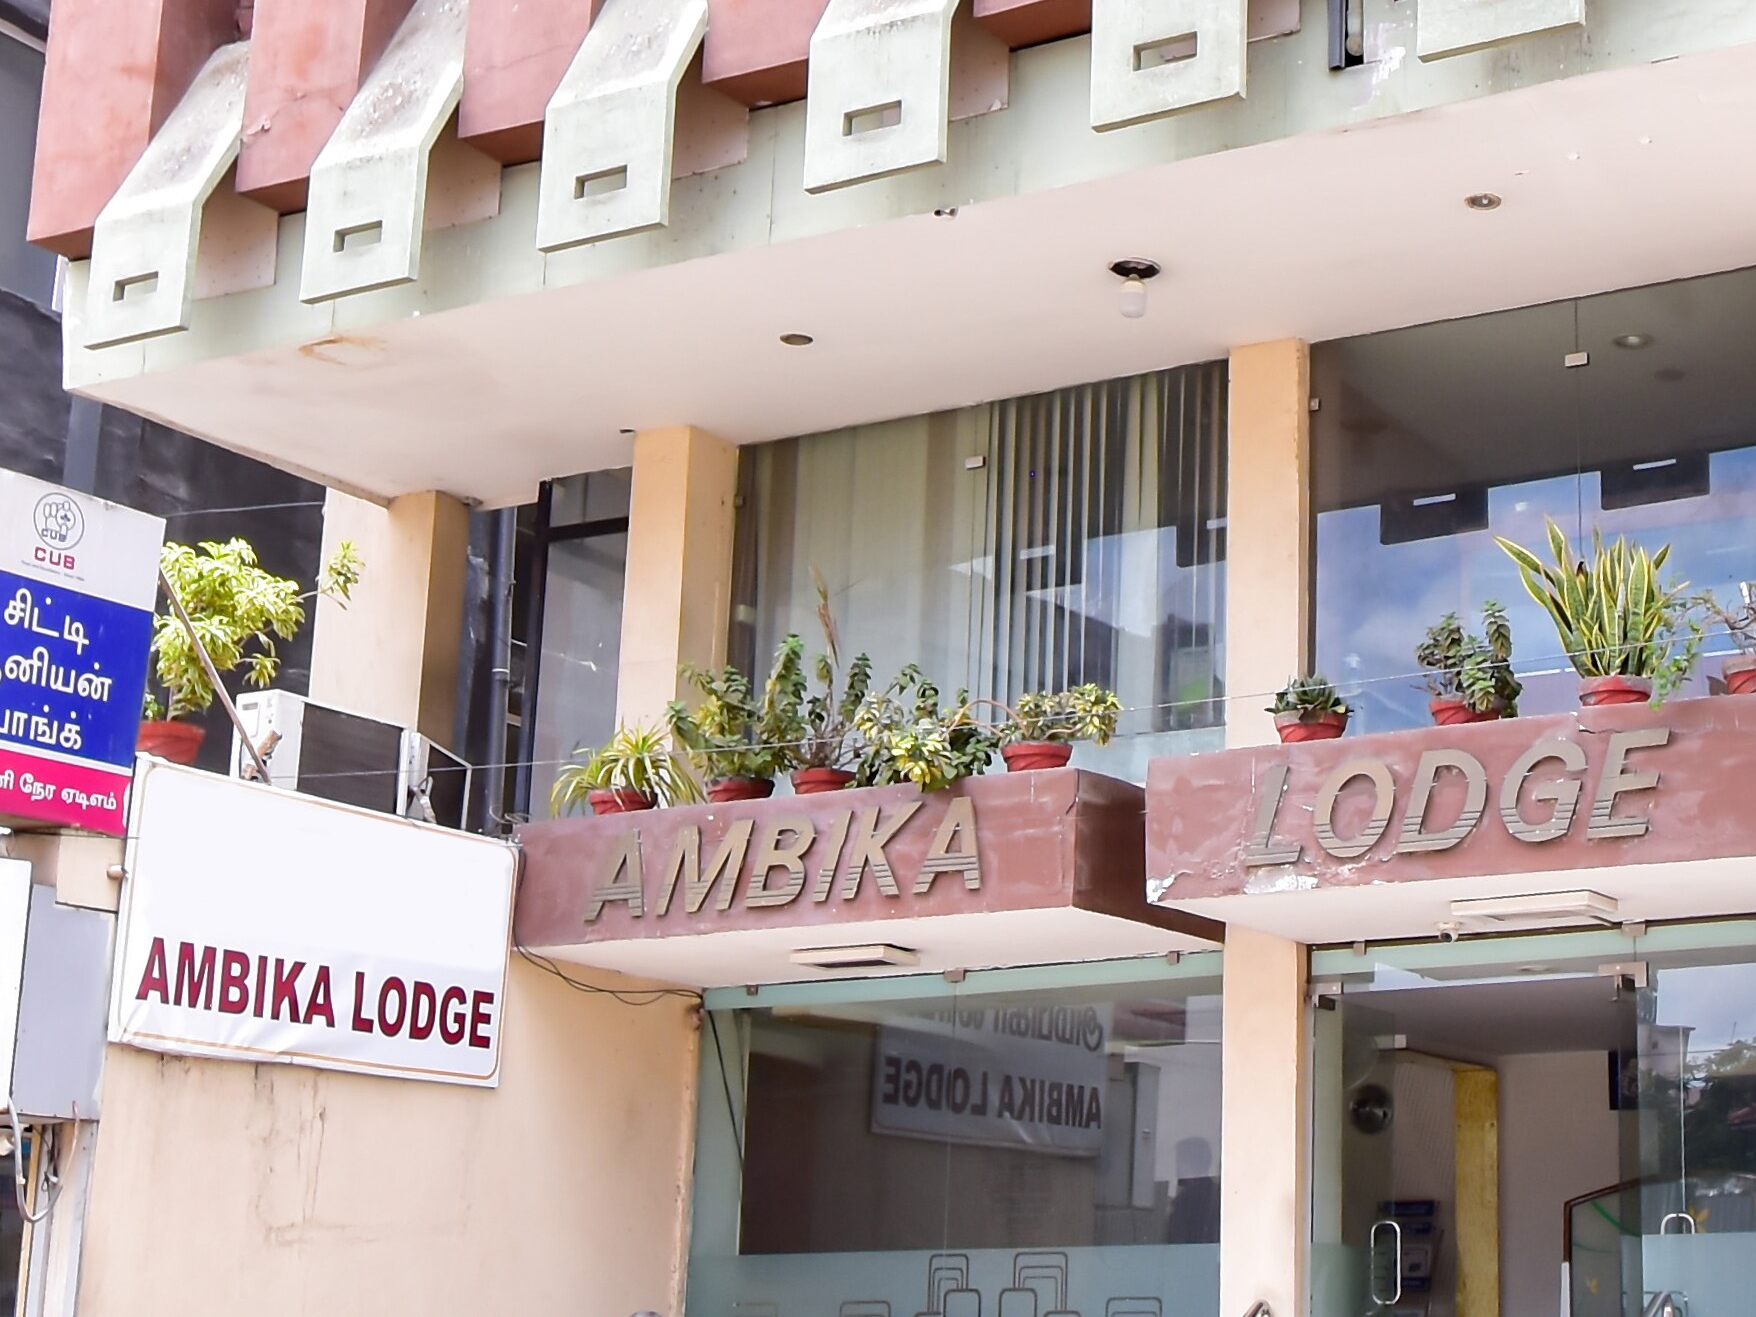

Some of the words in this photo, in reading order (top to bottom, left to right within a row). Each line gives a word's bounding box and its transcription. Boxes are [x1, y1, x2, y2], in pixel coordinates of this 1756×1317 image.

[34, 546, 76, 570] CUB
[4, 588, 89, 655] சிட்டி
[0, 646, 112, 702] னியன்
[19, 772, 56, 801] நேர
[61, 787, 117, 810] ஏடிஎம்
[1245, 727, 1671, 867] LODGE
[583, 796, 982, 922] AMBIKA
[135, 937, 336, 1028] AMBIKA
[352, 971, 495, 1049] LODGE
